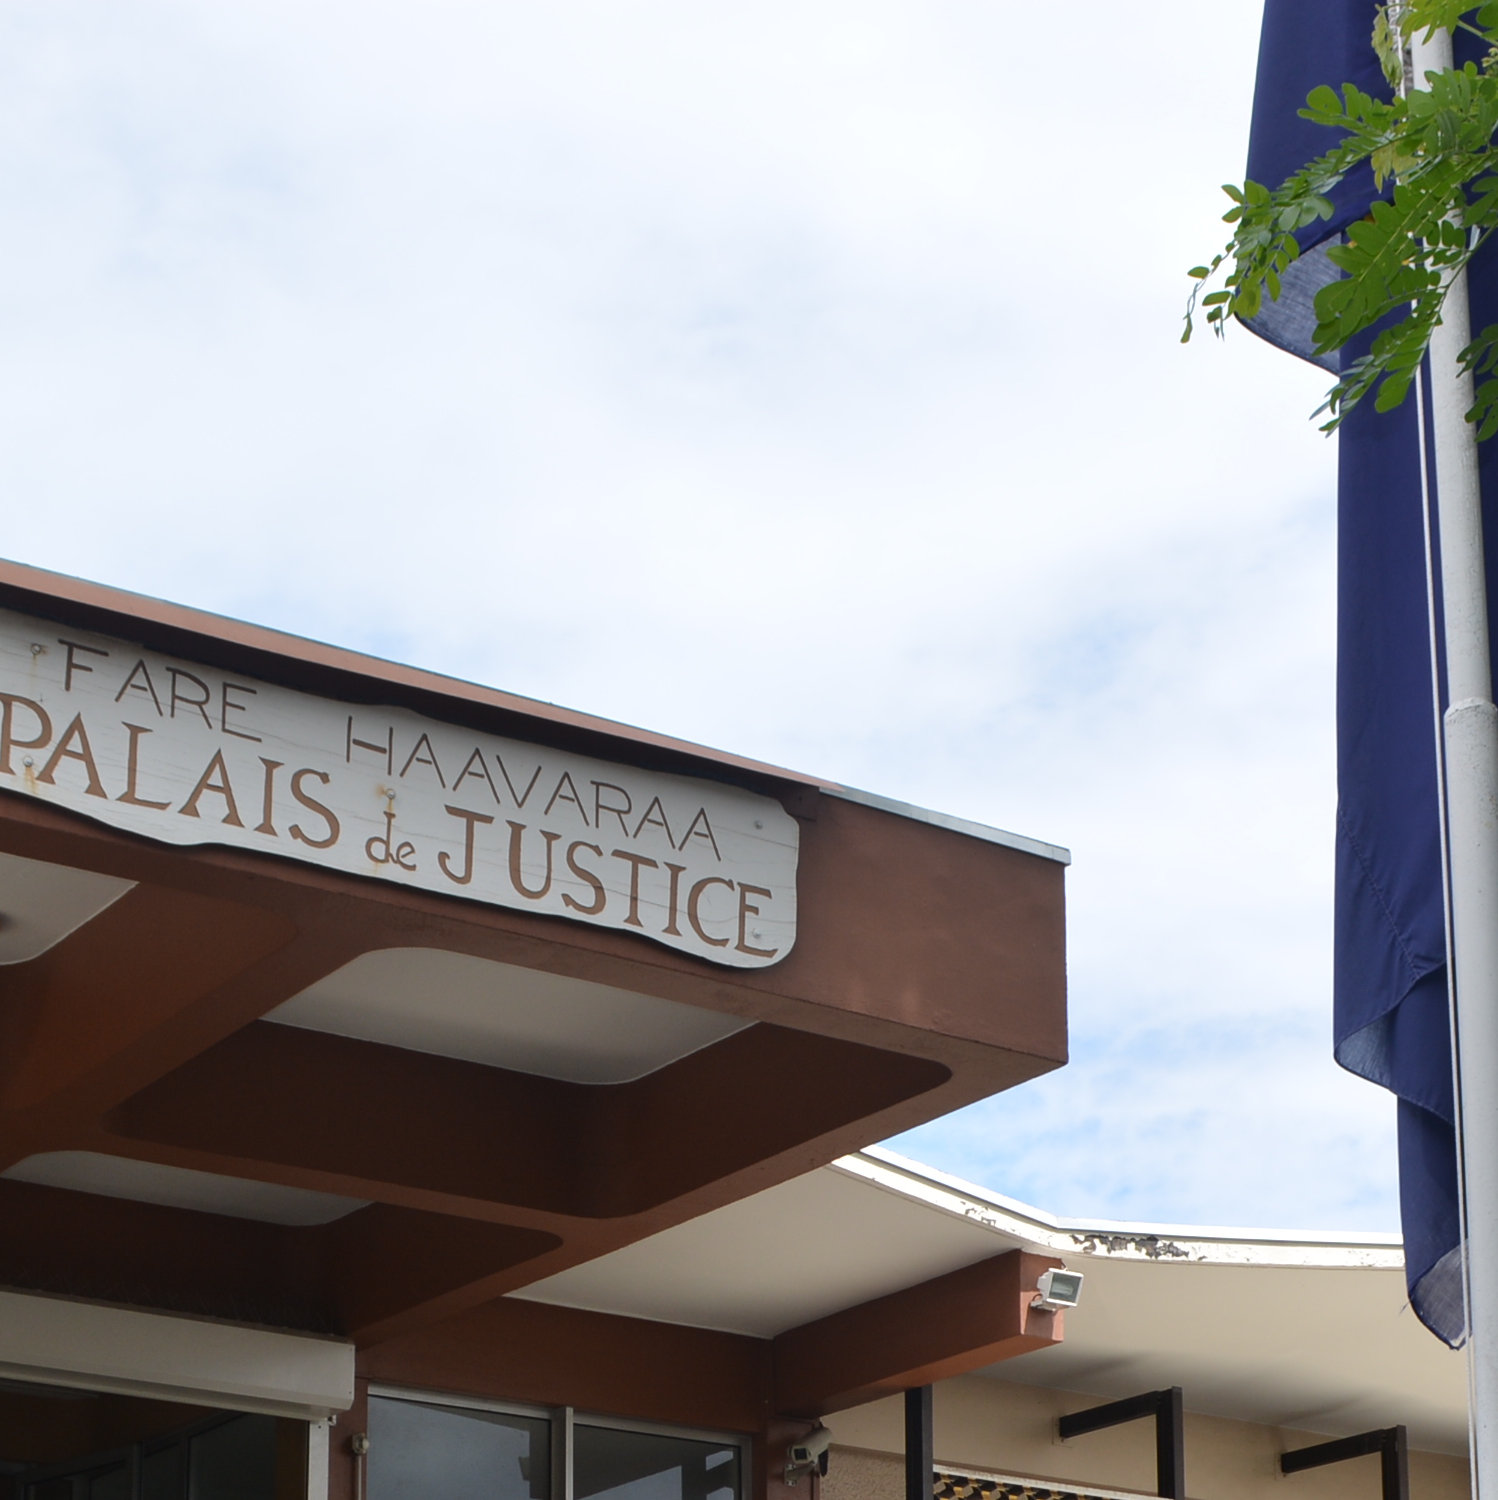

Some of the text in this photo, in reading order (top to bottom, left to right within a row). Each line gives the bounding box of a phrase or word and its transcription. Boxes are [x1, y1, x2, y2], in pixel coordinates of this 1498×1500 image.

[58, 638, 721, 861] FARE HAAVARAA
[365, 811, 417, 872] de
[437, 804, 778, 958] JUSTICE
